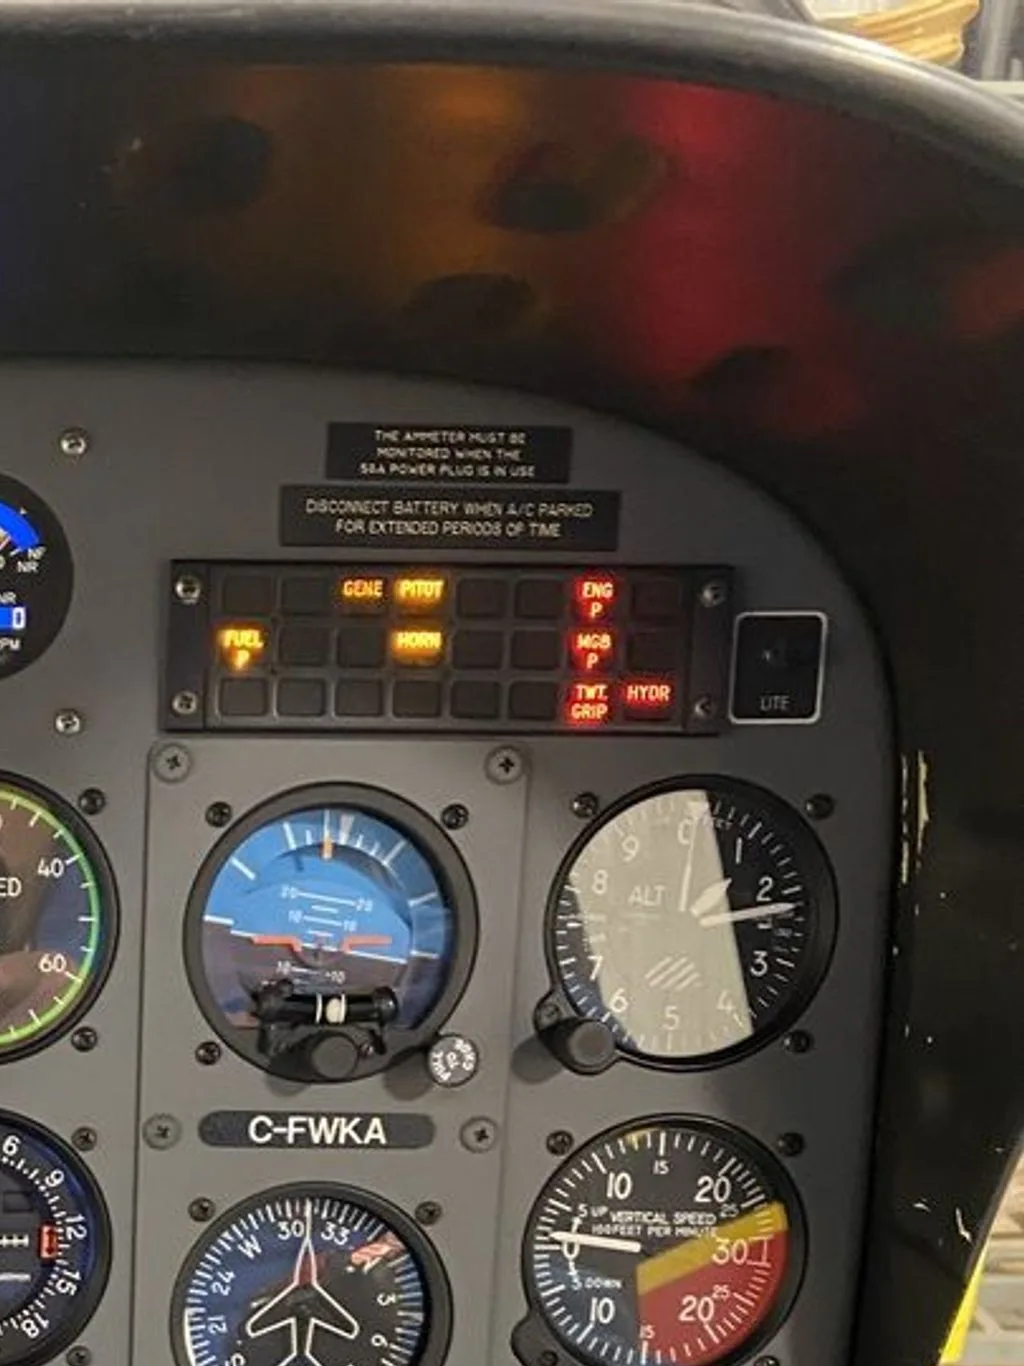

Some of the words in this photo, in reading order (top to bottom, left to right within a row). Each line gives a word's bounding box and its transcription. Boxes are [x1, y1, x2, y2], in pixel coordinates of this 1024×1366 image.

[439, 464, 474, 477] PLUG
[510, 465, 535, 477] USE
[306, 499, 390, 515] DISCONNECT
[393, 501, 461, 516] BATTERY
[464, 503, 504, 517] WHEN
[538, 504, 593, 518] PARKED
[336, 520, 365, 534] FOR
[369, 521, 438, 536] EXTENDED
[442, 522, 502, 537] PERIODS
[530, 523, 561, 537] TIME
[343, 580, 383, 597] GENE
[399, 580, 444, 598] PITOT
[582, 582, 614, 599] ENG
[11, 607, 25, 629] 0
[225, 630, 264, 649] FUEL
[397, 631, 442, 649] HORN
[627, 685, 671, 701] HYDR
[571, 704, 608, 719] GRIP
[37, 859, 64, 877] 40
[629, 885, 666, 905] ALT
[38, 954, 67, 973] 60
[248, 1116, 387, 1144] C-FWKA
[653, 1160, 669, 1175] 15
[606, 1172, 632, 1200] 10
[695, 1176, 732, 1203] 20
[65, 1214, 87, 1241] 12
[610, 1210, 669, 1225] VERTICAL
[673, 1212, 716, 1226] SPEED
[278, 1220, 304, 1239] 30
[321, 1221, 350, 1246] 33
[712, 1240, 749, 1265] 30
[590, 1297, 616, 1324] 10
[679, 1296, 715, 1322] 20
[640, 1325, 655, 1338] 15
